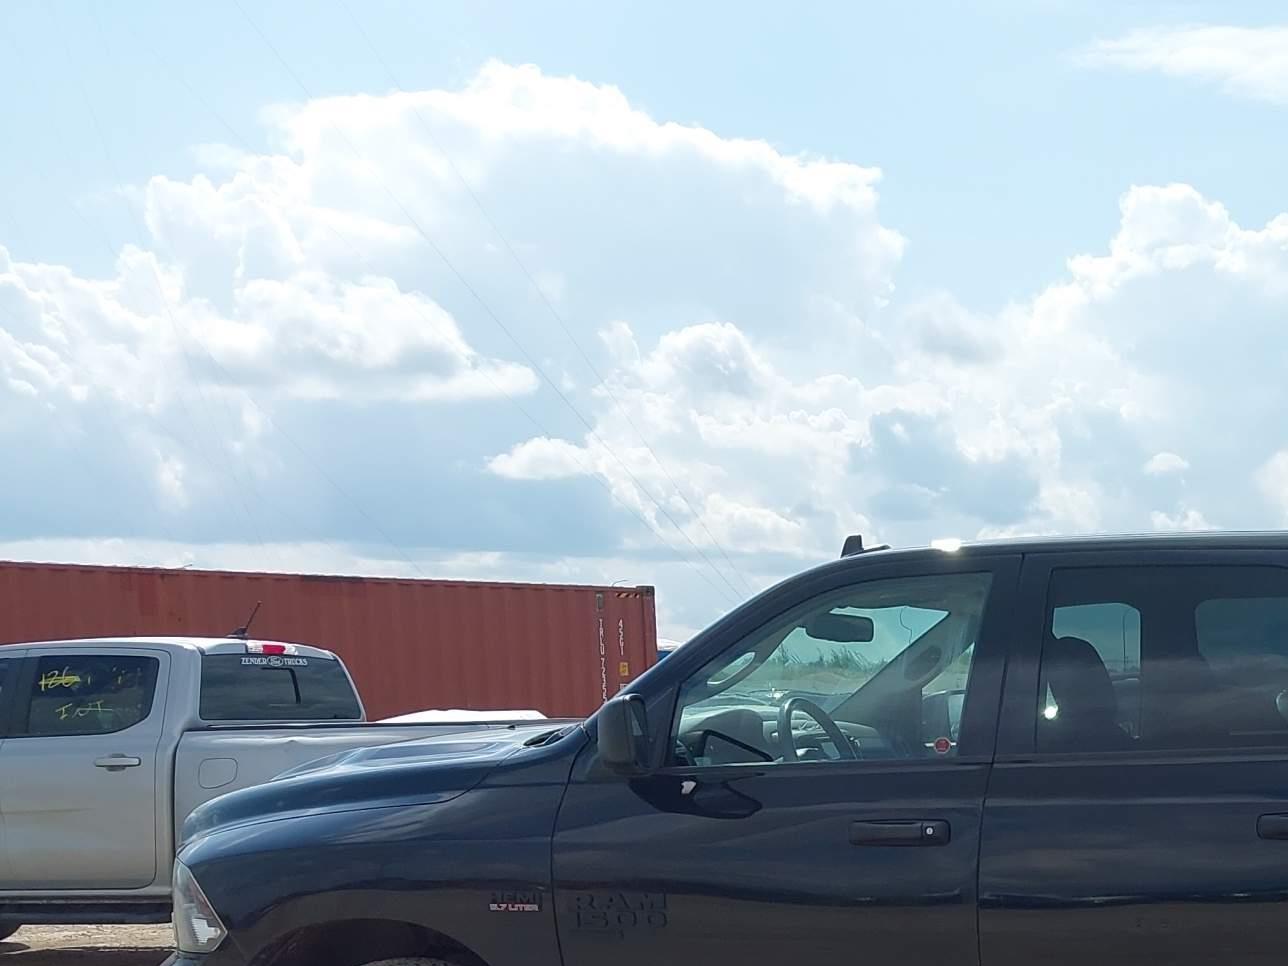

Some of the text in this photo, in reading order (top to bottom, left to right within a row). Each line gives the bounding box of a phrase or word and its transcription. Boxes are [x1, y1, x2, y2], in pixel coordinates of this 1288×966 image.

[240, 657, 267, 665] ZENDER
[575, 892, 667, 911] RAM
[576, 911, 668, 929] 1500
